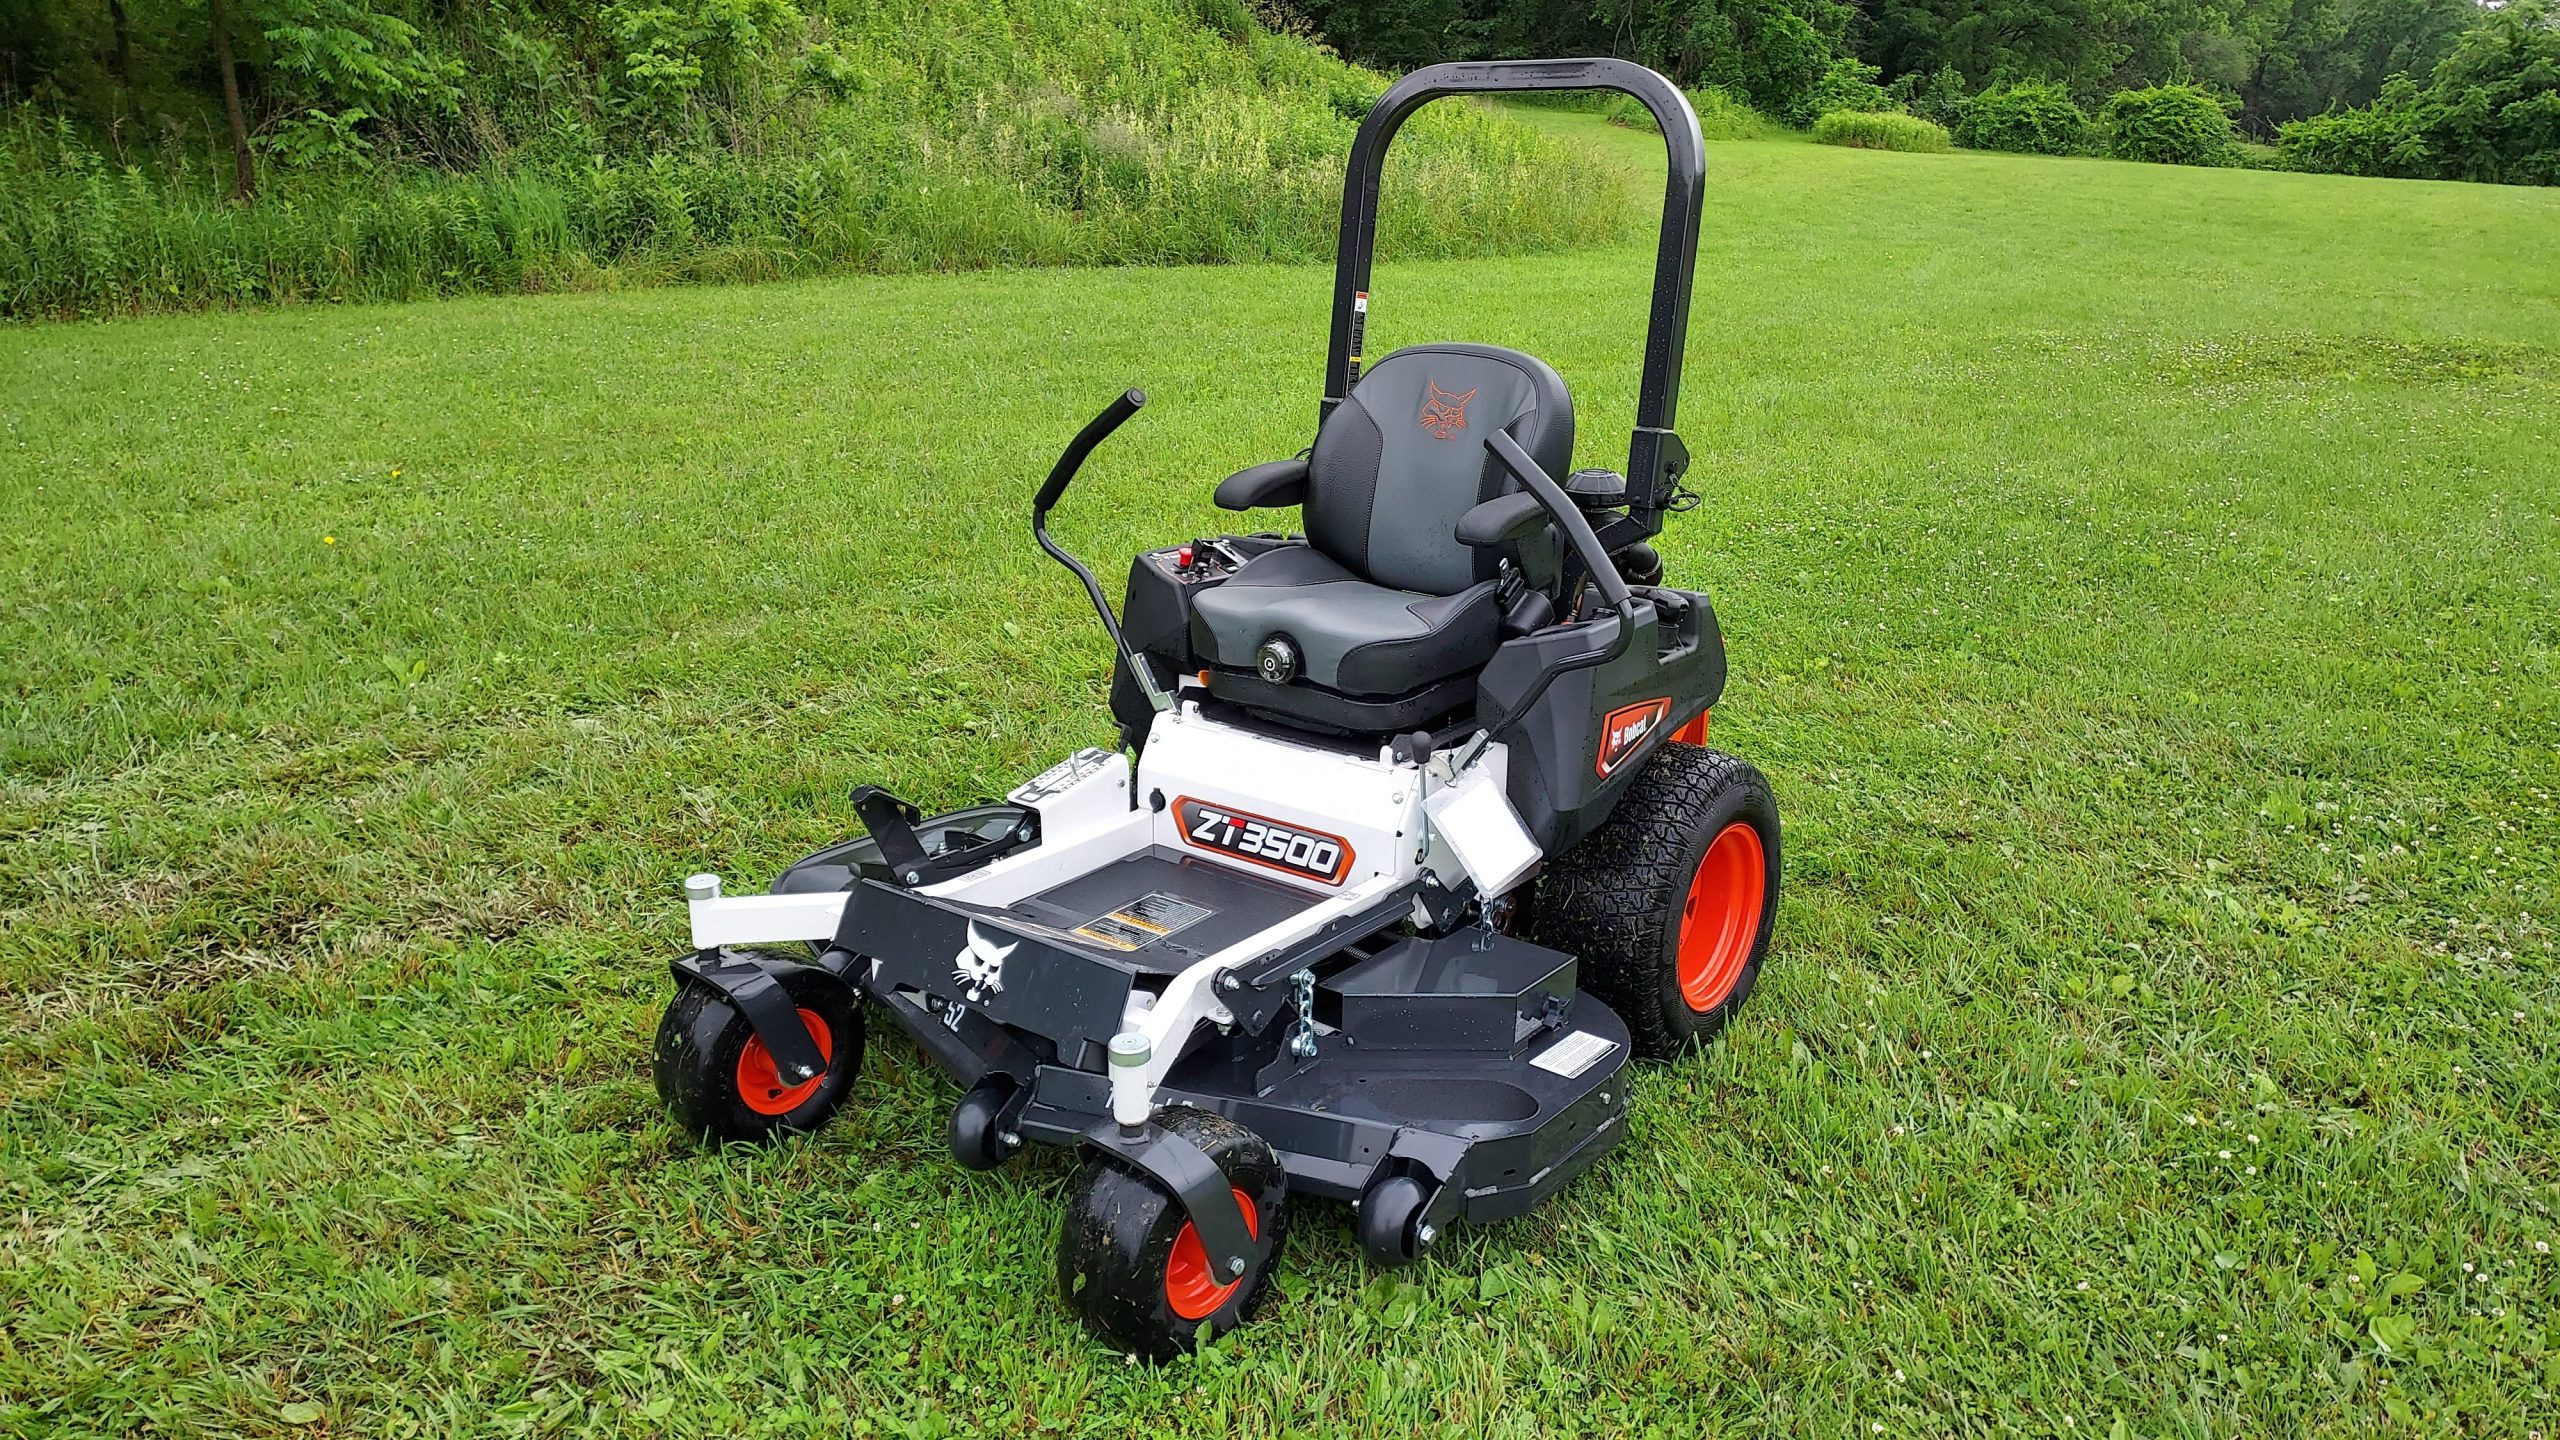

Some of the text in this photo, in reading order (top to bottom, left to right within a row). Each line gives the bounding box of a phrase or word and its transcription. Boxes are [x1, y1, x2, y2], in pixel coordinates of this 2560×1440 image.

[1623, 714, 1647, 746] Bobcat
[1191, 809, 1341, 875] ZT3500
[943, 1001, 966, 1033] 52
